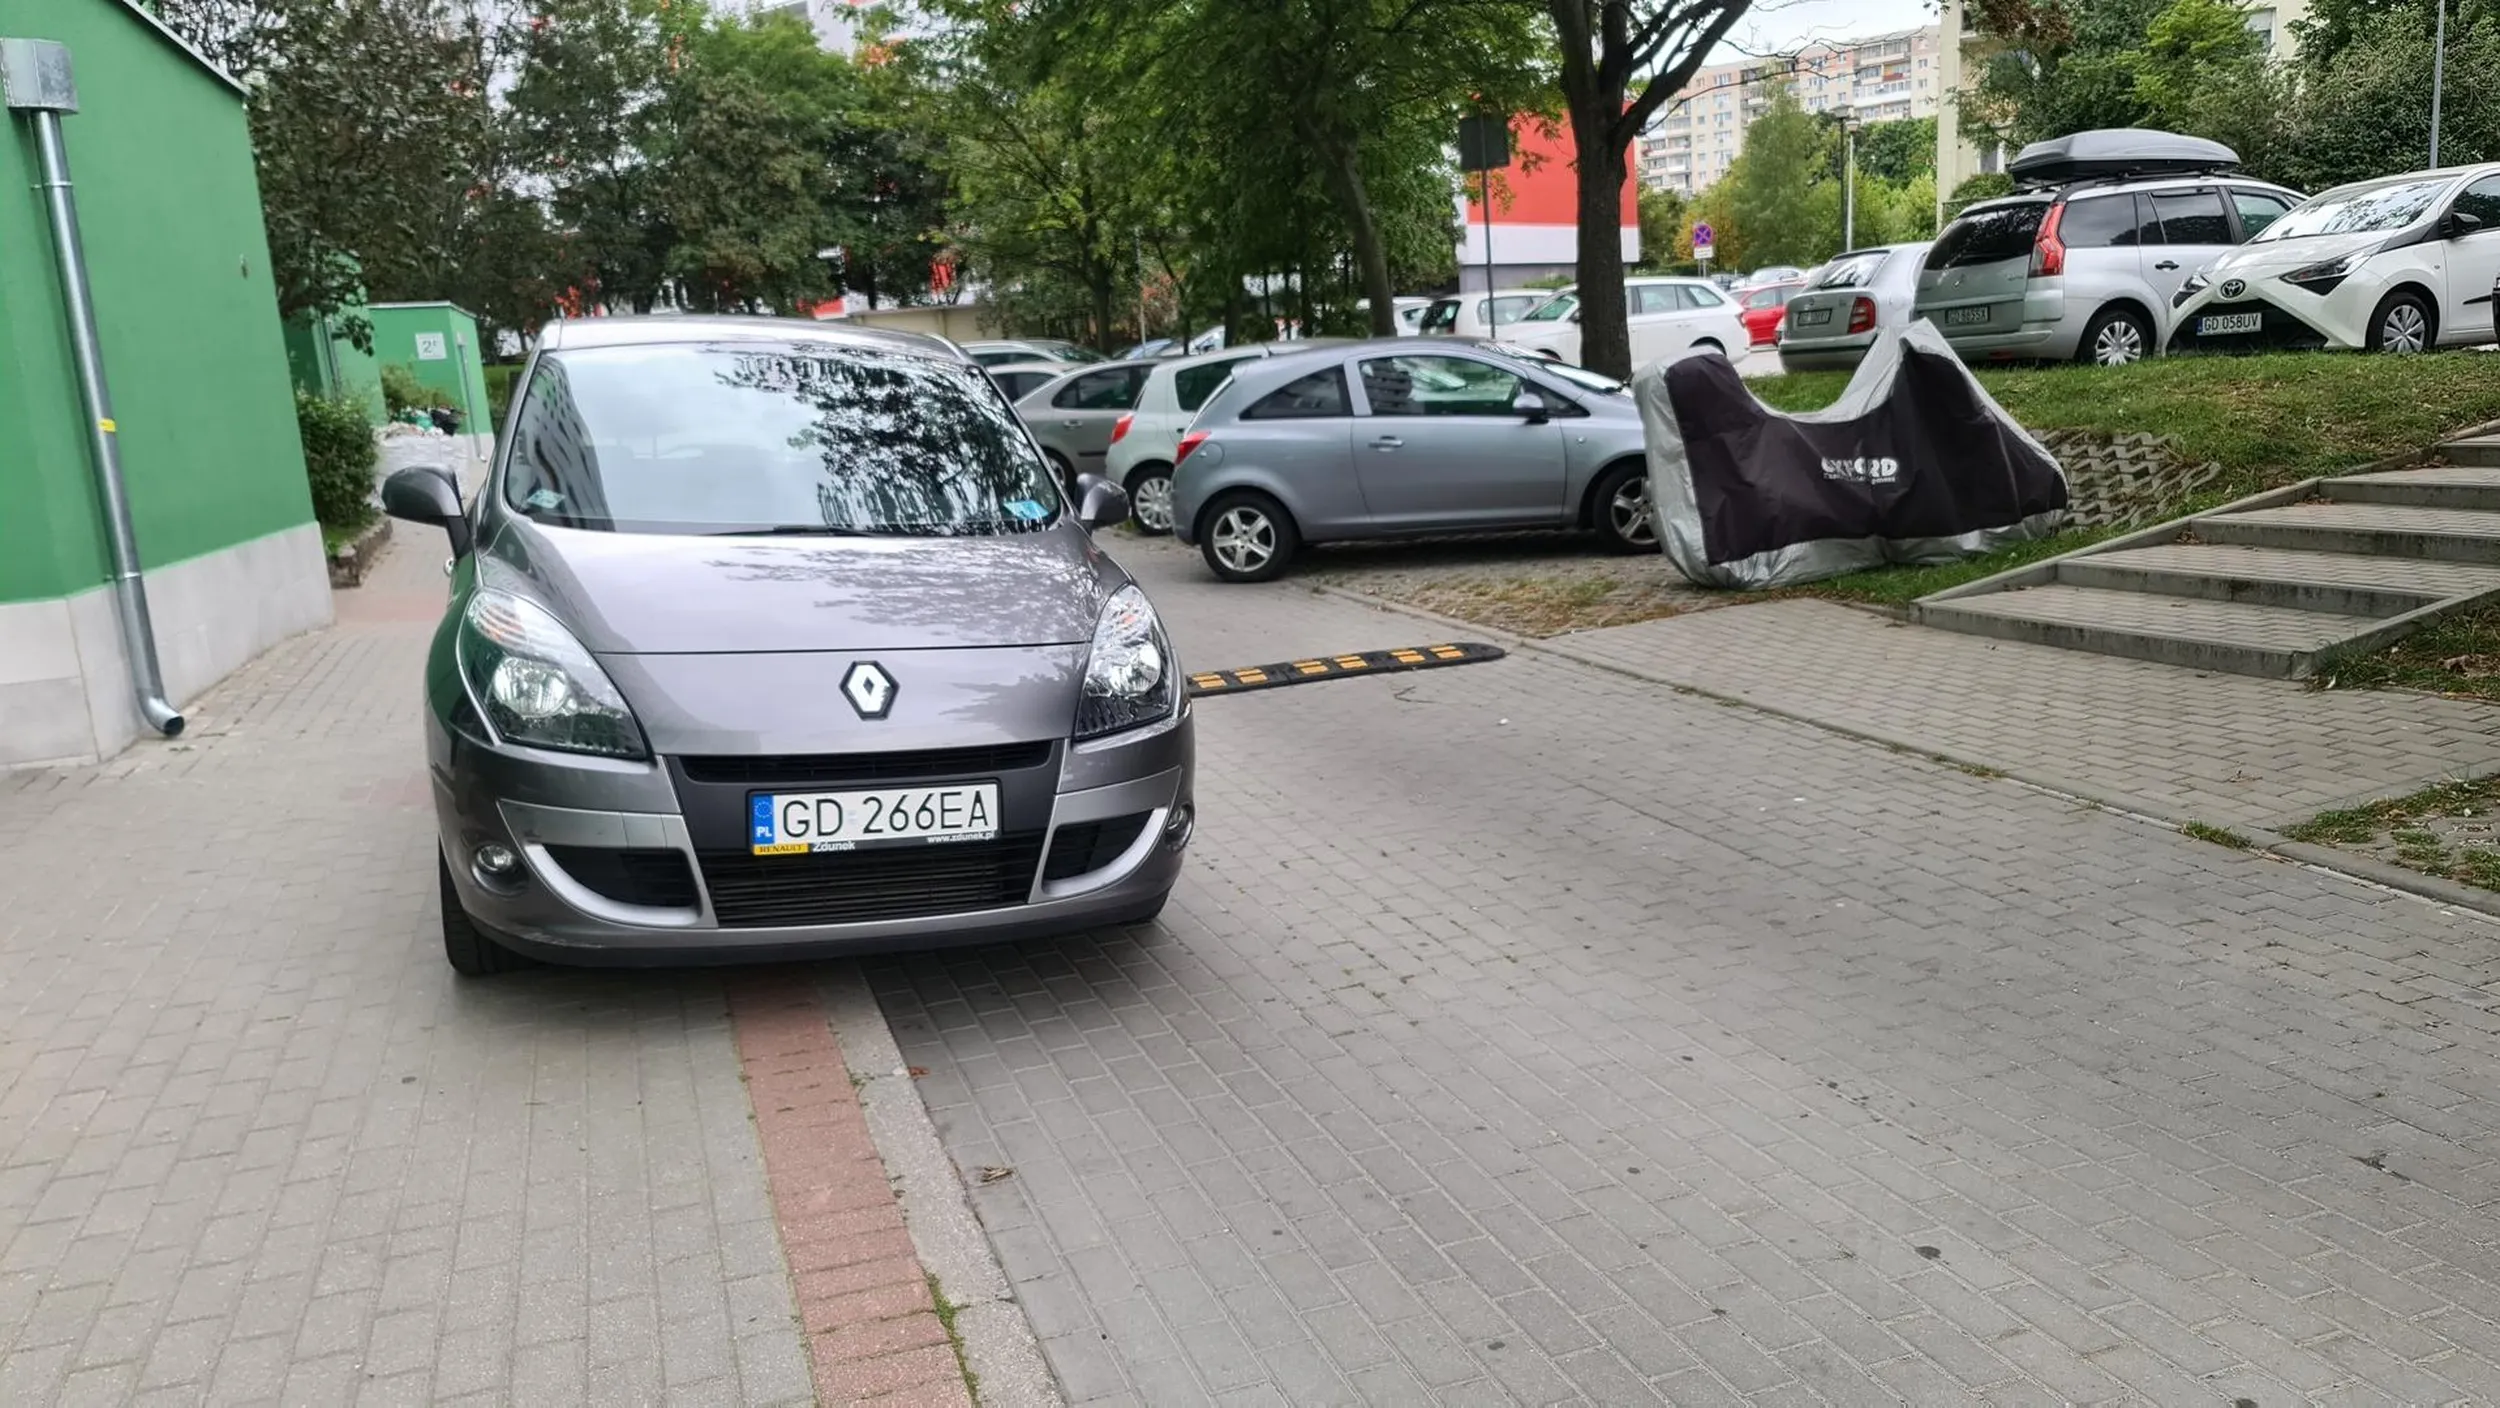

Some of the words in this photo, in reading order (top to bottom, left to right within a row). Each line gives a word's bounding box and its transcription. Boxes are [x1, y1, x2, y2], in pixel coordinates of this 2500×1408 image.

[2204, 317, 2219, 331] GD
[2222, 314, 2258, 329] 058UV
[1820, 456, 1898, 478] OXFORD
[782, 798, 843, 838] GD
[862, 790, 988, 834] 266EA
[756, 826, 772, 838] PL
[812, 840, 856, 853] Zdunek
[927, 830, 996, 844] www.zdunek.pl
